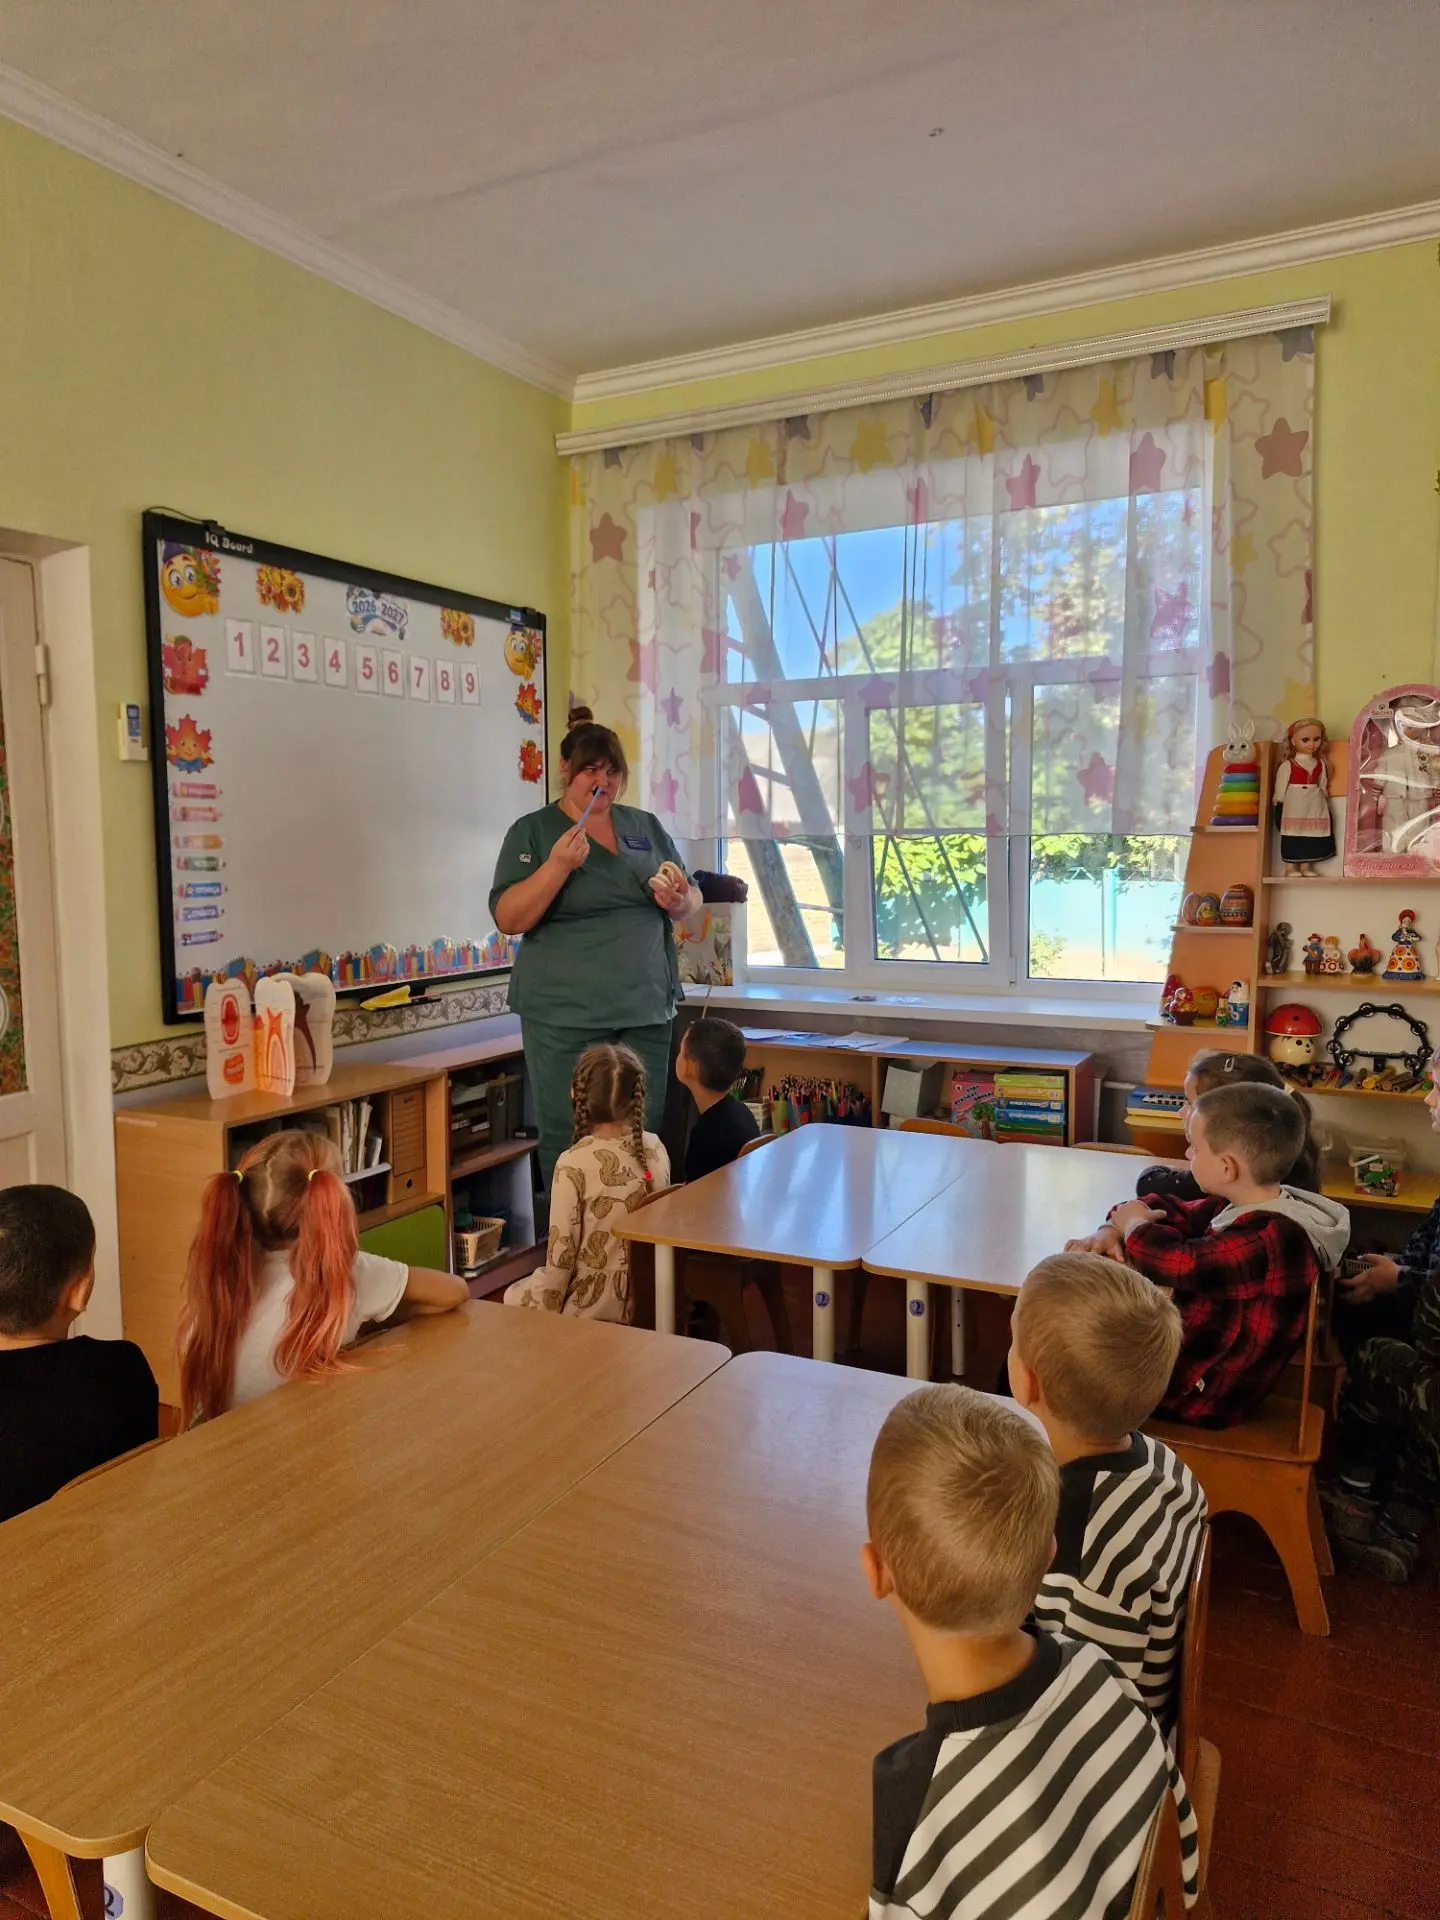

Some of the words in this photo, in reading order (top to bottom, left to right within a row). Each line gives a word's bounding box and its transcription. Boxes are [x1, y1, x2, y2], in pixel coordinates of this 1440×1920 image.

[205, 531, 220, 548] IQ
[222, 537, 254, 554] Board
[381, 603, 404, 624] 2027
[234, 632, 244, 657] 1
[267, 638, 280, 663] 2
[297, 643, 310, 668] 3
[329, 649, 341, 673] 4
[362, 656, 373, 680] 5
[388, 661, 399, 684] 6
[414, 665, 424, 688] 7
[440, 670, 450, 691] 8
[465, 672, 475, 693] 9
[816, 1292, 827, 1307] 2
[910, 1300, 922, 1315] 2
